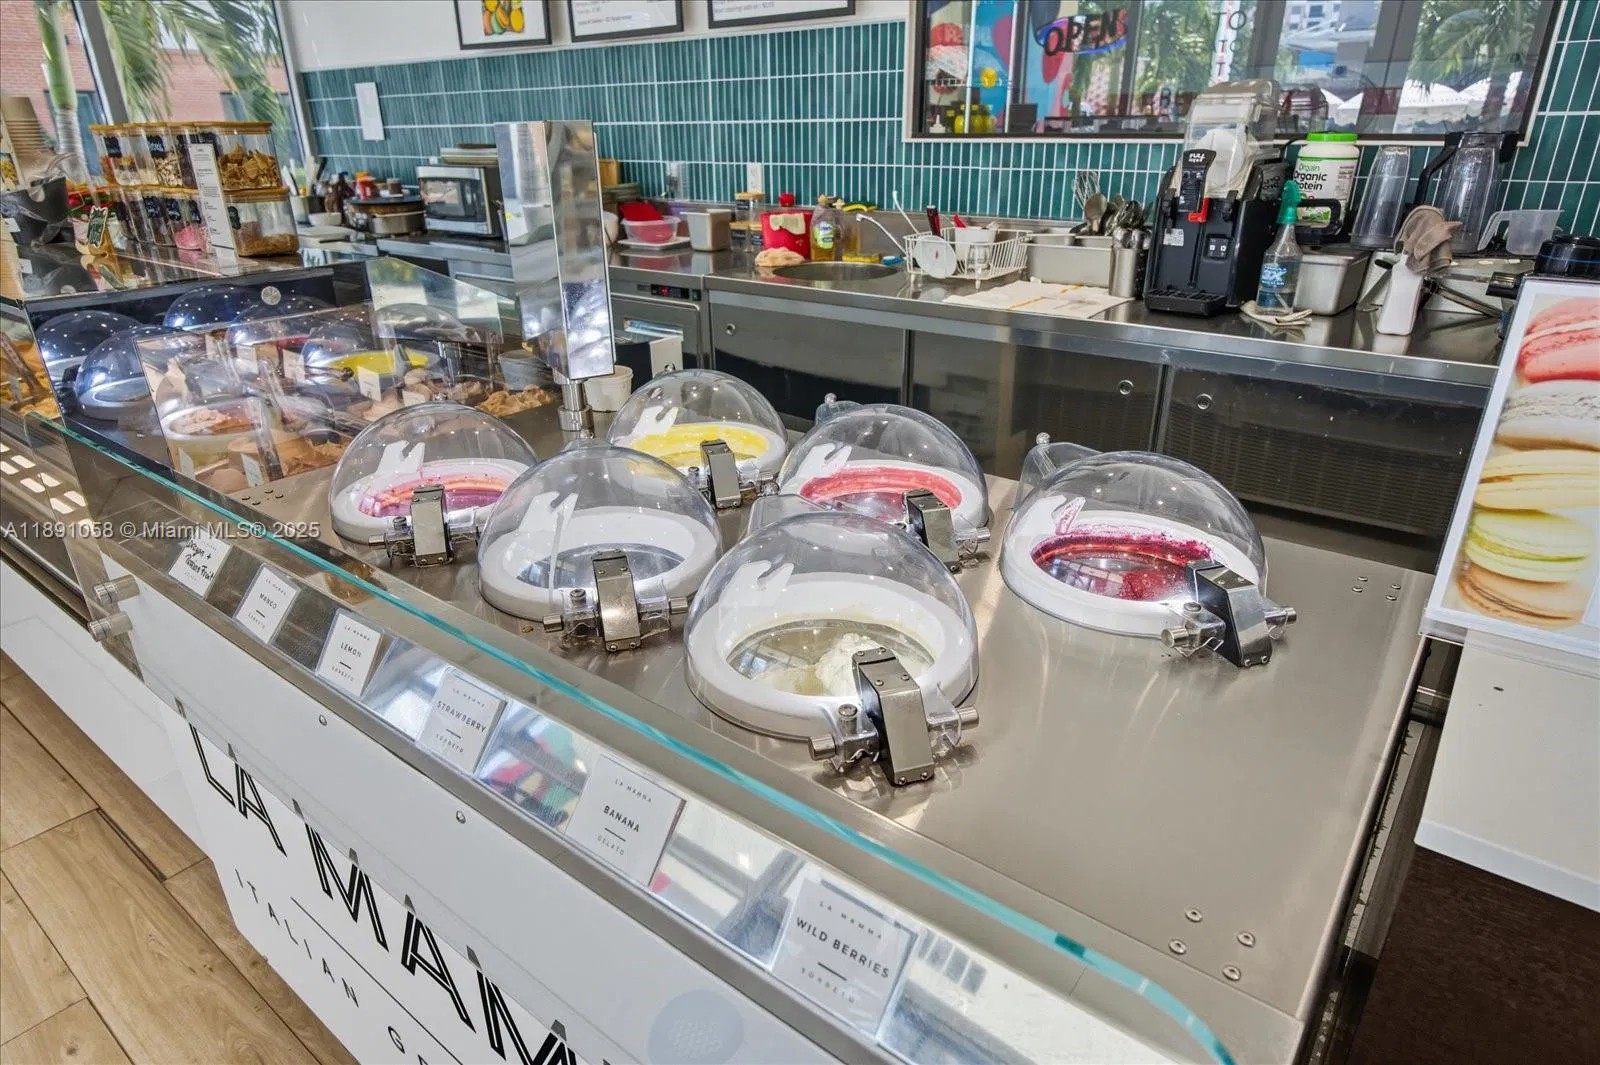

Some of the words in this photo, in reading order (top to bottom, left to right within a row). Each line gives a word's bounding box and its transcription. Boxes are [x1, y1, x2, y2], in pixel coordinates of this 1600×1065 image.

[1044, 8, 1121, 56] OPEN
[1293, 171, 1328, 182] Organic
[259, 592, 277, 610] MANGO
[340, 642, 362, 658] LEMON
[437, 700, 487, 733] STRAWBERRY
[186, 715, 288, 858] LA
[603, 805, 640, 833] BANANA
[234, 868, 359, 1008] ITALIAN
[796, 916, 828, 942] WILD
[832, 938, 889, 979] BERRIES
